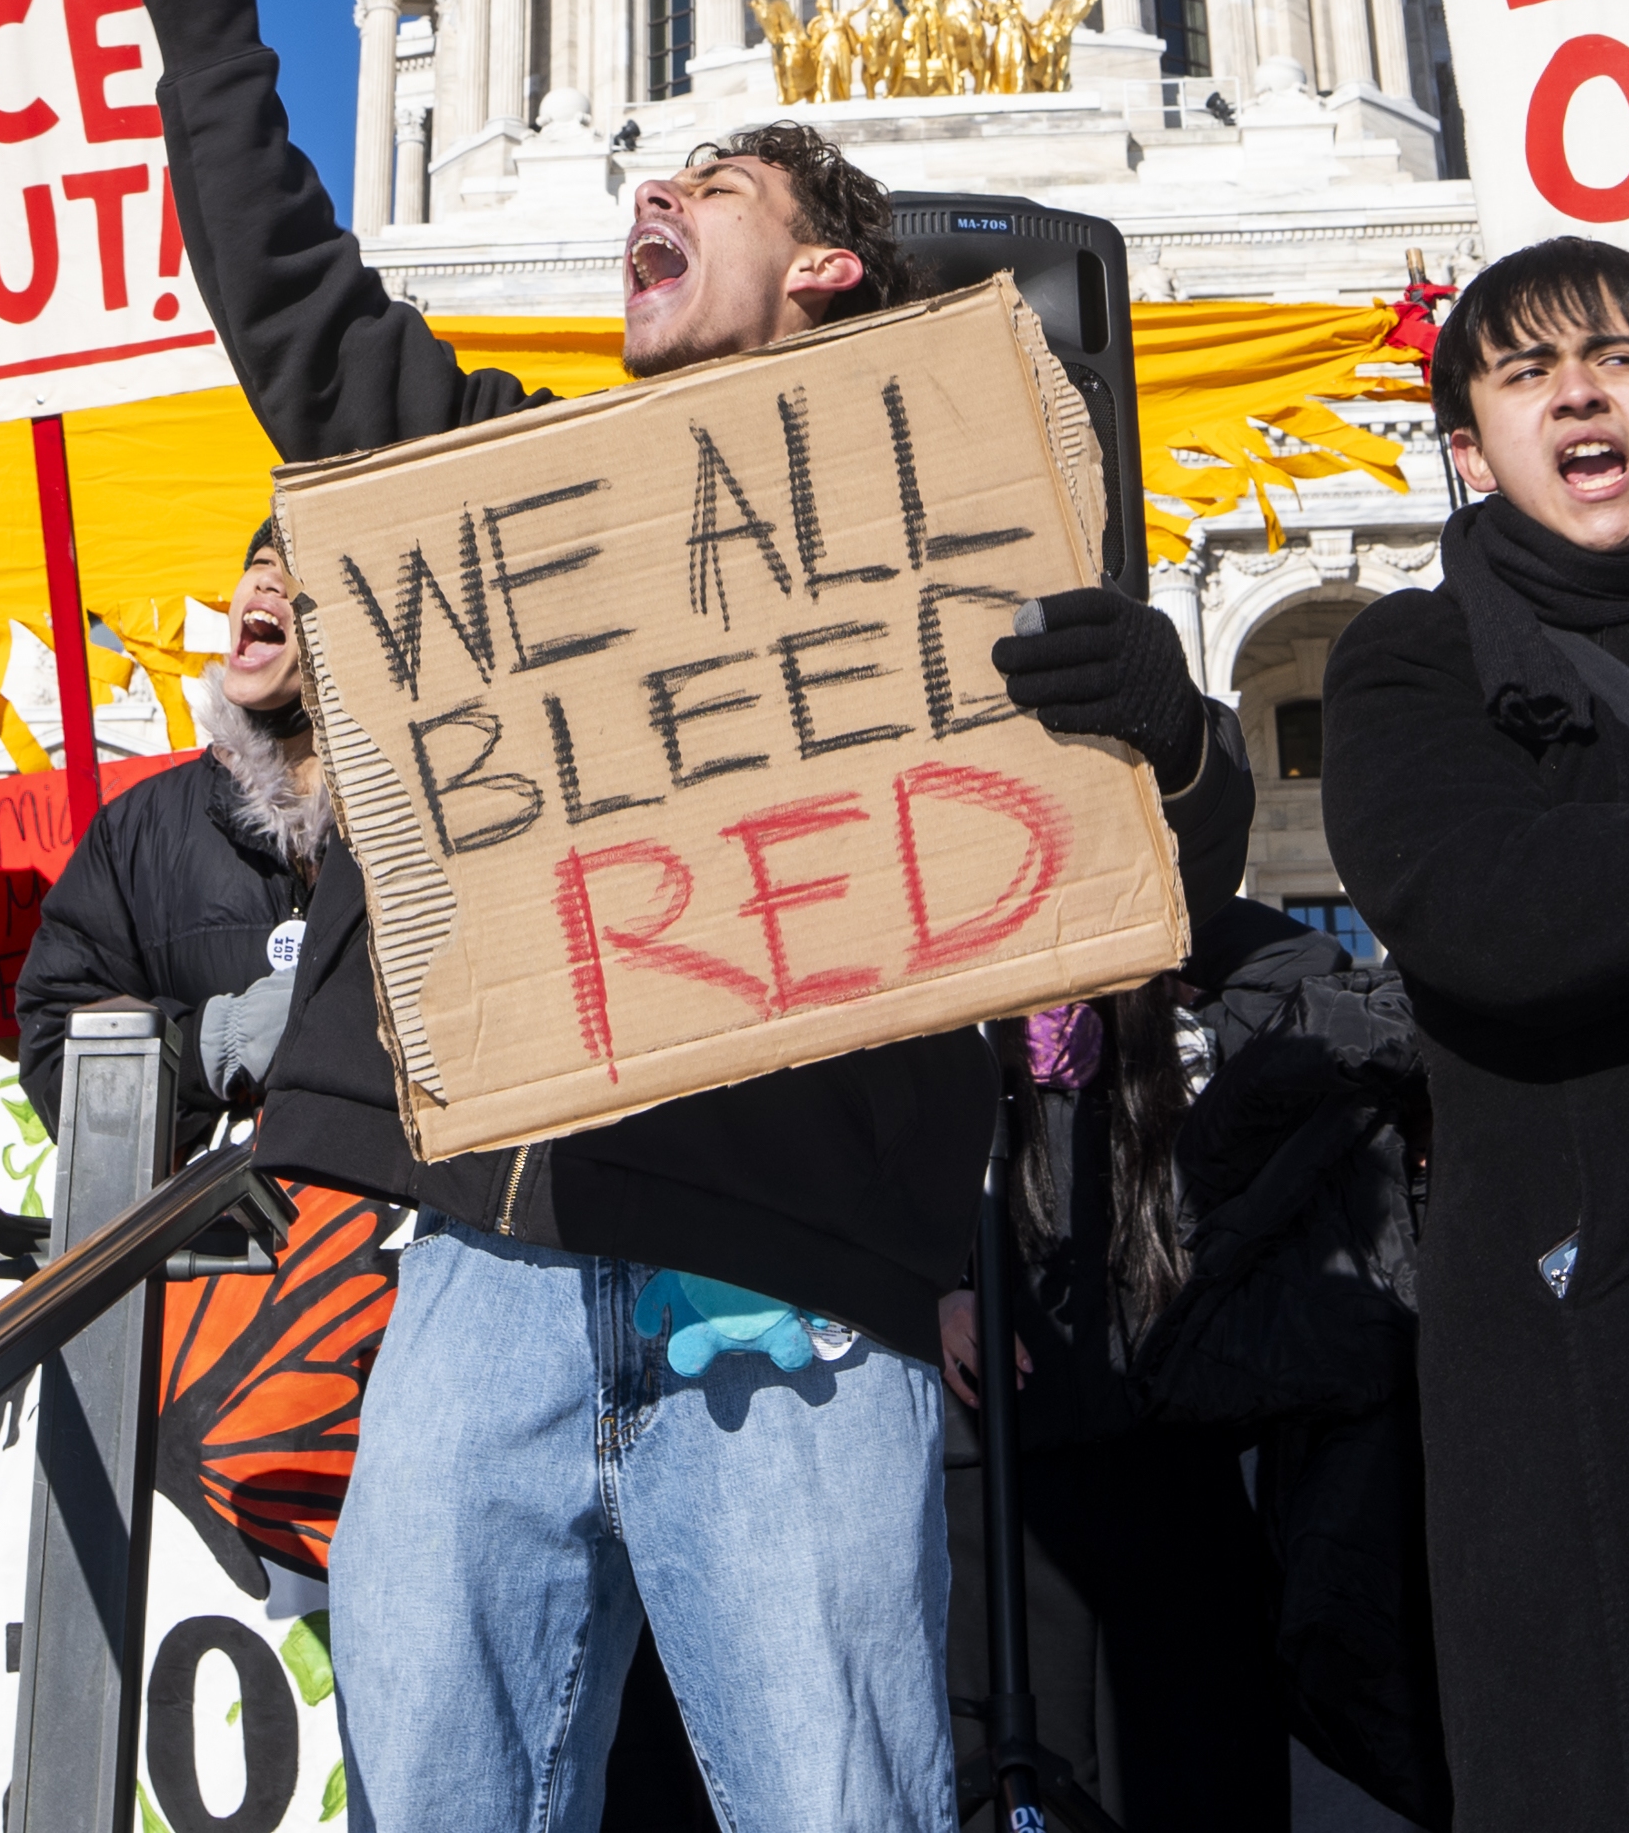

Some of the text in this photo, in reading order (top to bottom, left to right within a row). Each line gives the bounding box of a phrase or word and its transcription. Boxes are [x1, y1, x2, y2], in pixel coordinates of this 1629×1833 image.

[956, 217, 1008, 231] MA-708
[340, 374, 1035, 702] WE ALL
[408, 582, 1034, 856] BLEED
[273, 937, 284, 960] ICE
[283, 935, 296, 962] OUT
[554, 761, 1074, 1084] RED
